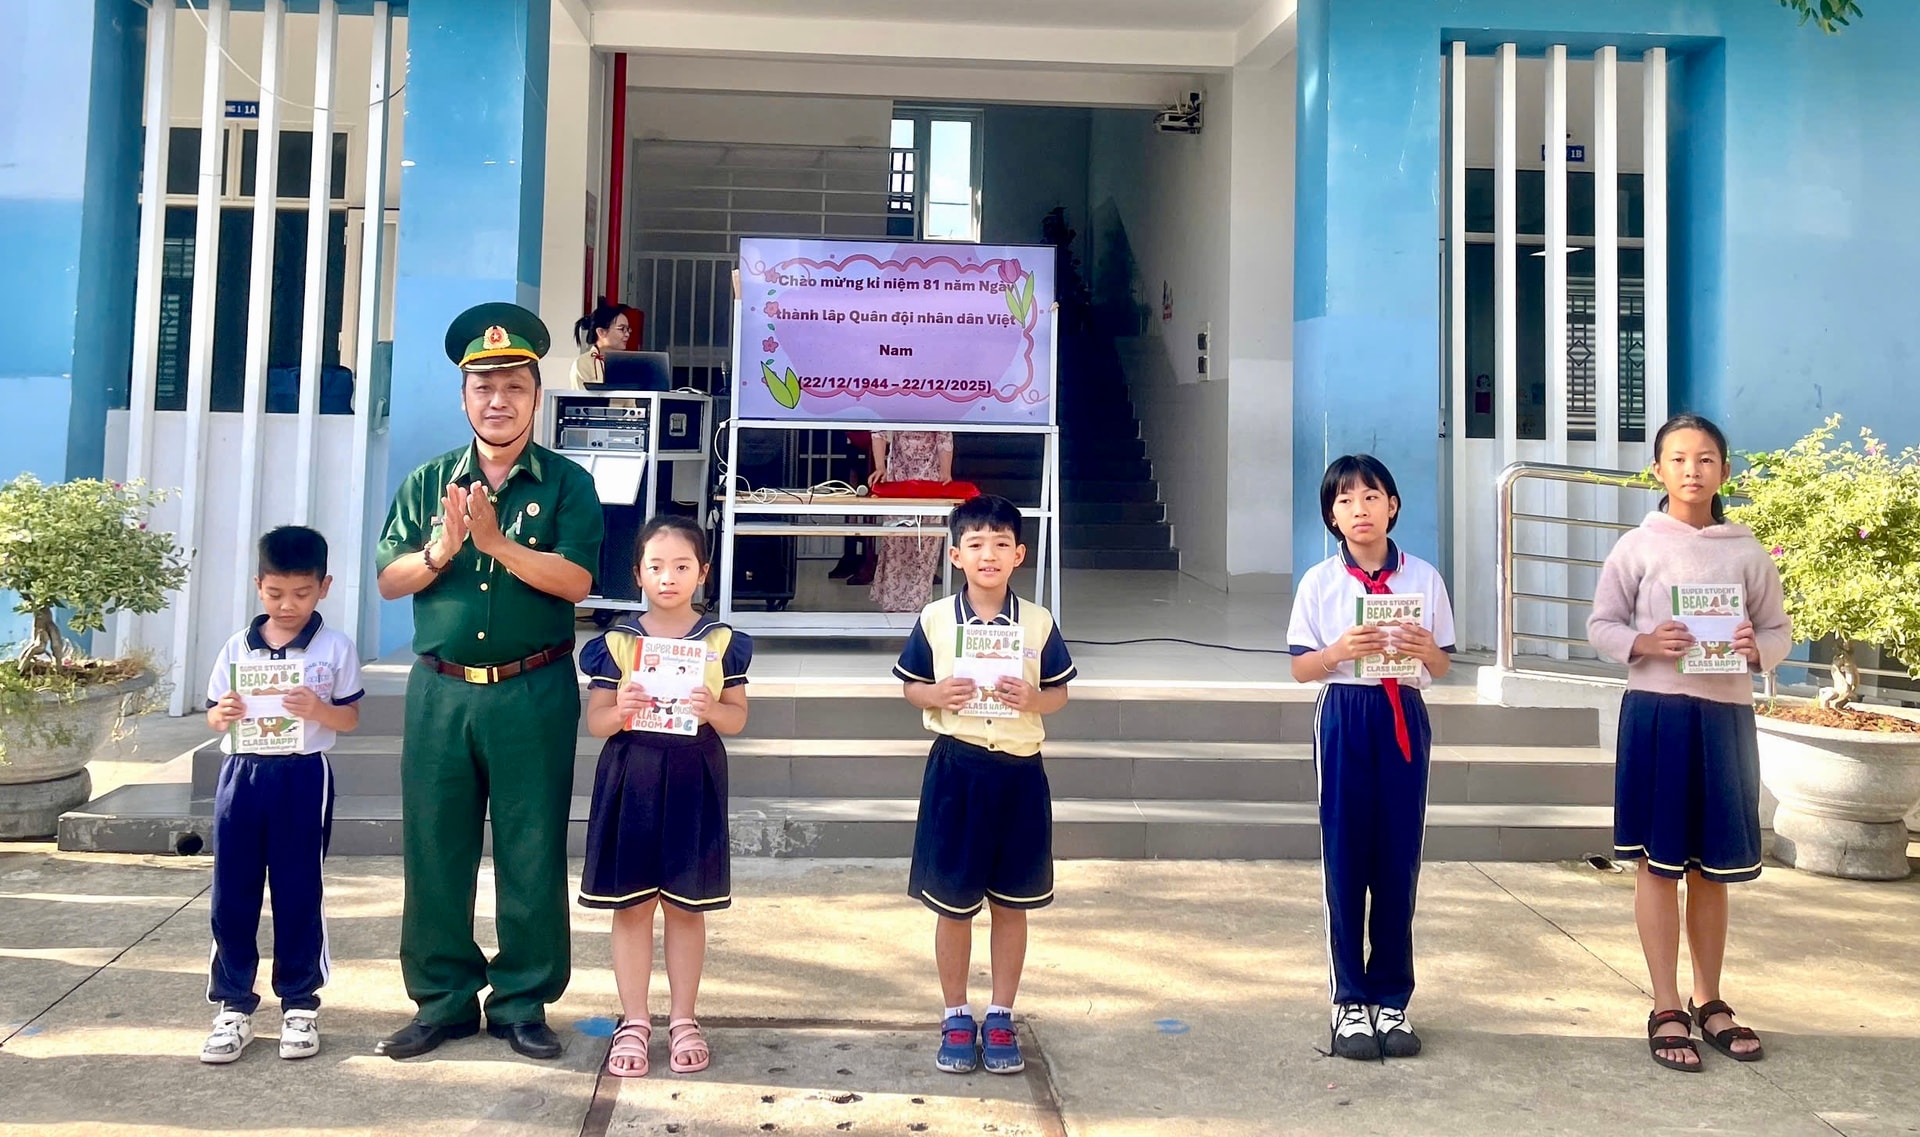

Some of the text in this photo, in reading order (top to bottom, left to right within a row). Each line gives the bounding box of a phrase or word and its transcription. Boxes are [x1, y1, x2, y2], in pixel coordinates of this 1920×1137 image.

[244, 105, 257, 115] 1A
[1571, 150, 1583, 158] 1B
[779, 274, 817, 287] Chào
[820, 276, 864, 291] mừng
[867, 276, 880, 289] kỉ
[884, 278, 919, 292] niệm
[923, 279, 940, 290] 81
[944, 280, 975, 291] năm
[776, 308, 819, 321] thành
[849, 310, 888, 324] Quân
[891, 311, 914, 326] đội
[917, 312, 953, 324] nhân
[956, 313, 984, 325] dân
[987, 313, 1017, 328] Việt
[879, 344, 913, 356] Nam
[798, 376, 888, 390] (22/12/1944
[902, 378, 992, 393] 22/12/2025)
[1681, 587, 1703, 595] SUPER
[1682, 595, 1709, 609] BEAR
[1366, 607, 1392, 619] BEAR
[989, 629, 1018, 637] STUDENT
[645, 642, 672, 654] SUPER
[672, 645, 702, 657] BEAR
[966, 637, 991, 650] BEAR
[240, 673, 268, 687] BEAR
[636, 720, 663, 729] ROOM
[270, 737, 298, 745] HAPPY
